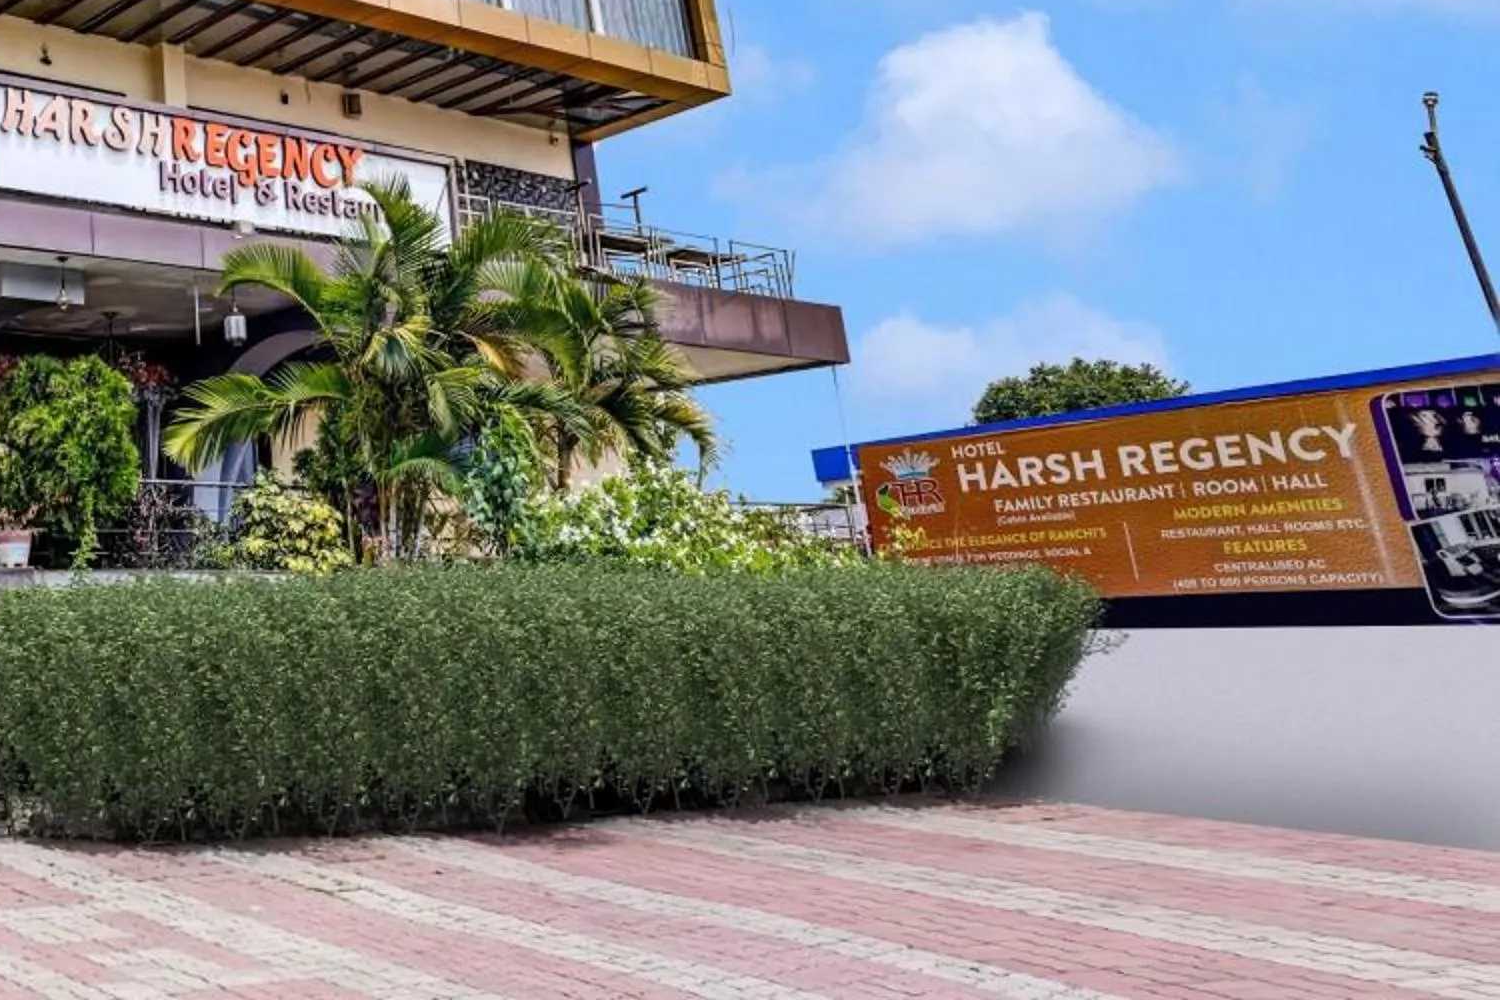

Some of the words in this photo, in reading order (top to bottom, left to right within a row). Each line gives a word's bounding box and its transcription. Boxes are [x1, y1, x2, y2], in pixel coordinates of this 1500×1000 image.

[0, 87, 166, 158] HARSH
[169, 117, 364, 188] REGENCY
[159, 160, 238, 205] Hotel
[255, 178, 278, 206] &
[951, 441, 1006, 459] HOTEL
[957, 449, 1107, 493] HARSH
[1117, 423, 1356, 478] REGENCY
[995, 495, 1052, 513] FAMILY
[1058, 483, 1175, 508] RESTAURANT
[1193, 478, 1258, 497] ROOM
[1272, 473, 1328, 491] HALL
[1173, 502, 1246, 521] MODERN
[1250, 497, 1343, 516] AMENITIES
[1247, 523, 1281, 535] HALL
[1284, 519, 1334, 533] ROOMS
[968, 533, 1028, 548] ELEGANCE
[1030, 531, 1046, 543] OF
[1223, 538, 1308, 555] FEATURES
[1307, 558, 1327, 570] AC
[1242, 574, 1306, 587] PERSONS
[1309, 572, 1384, 586] CAPACITY)
